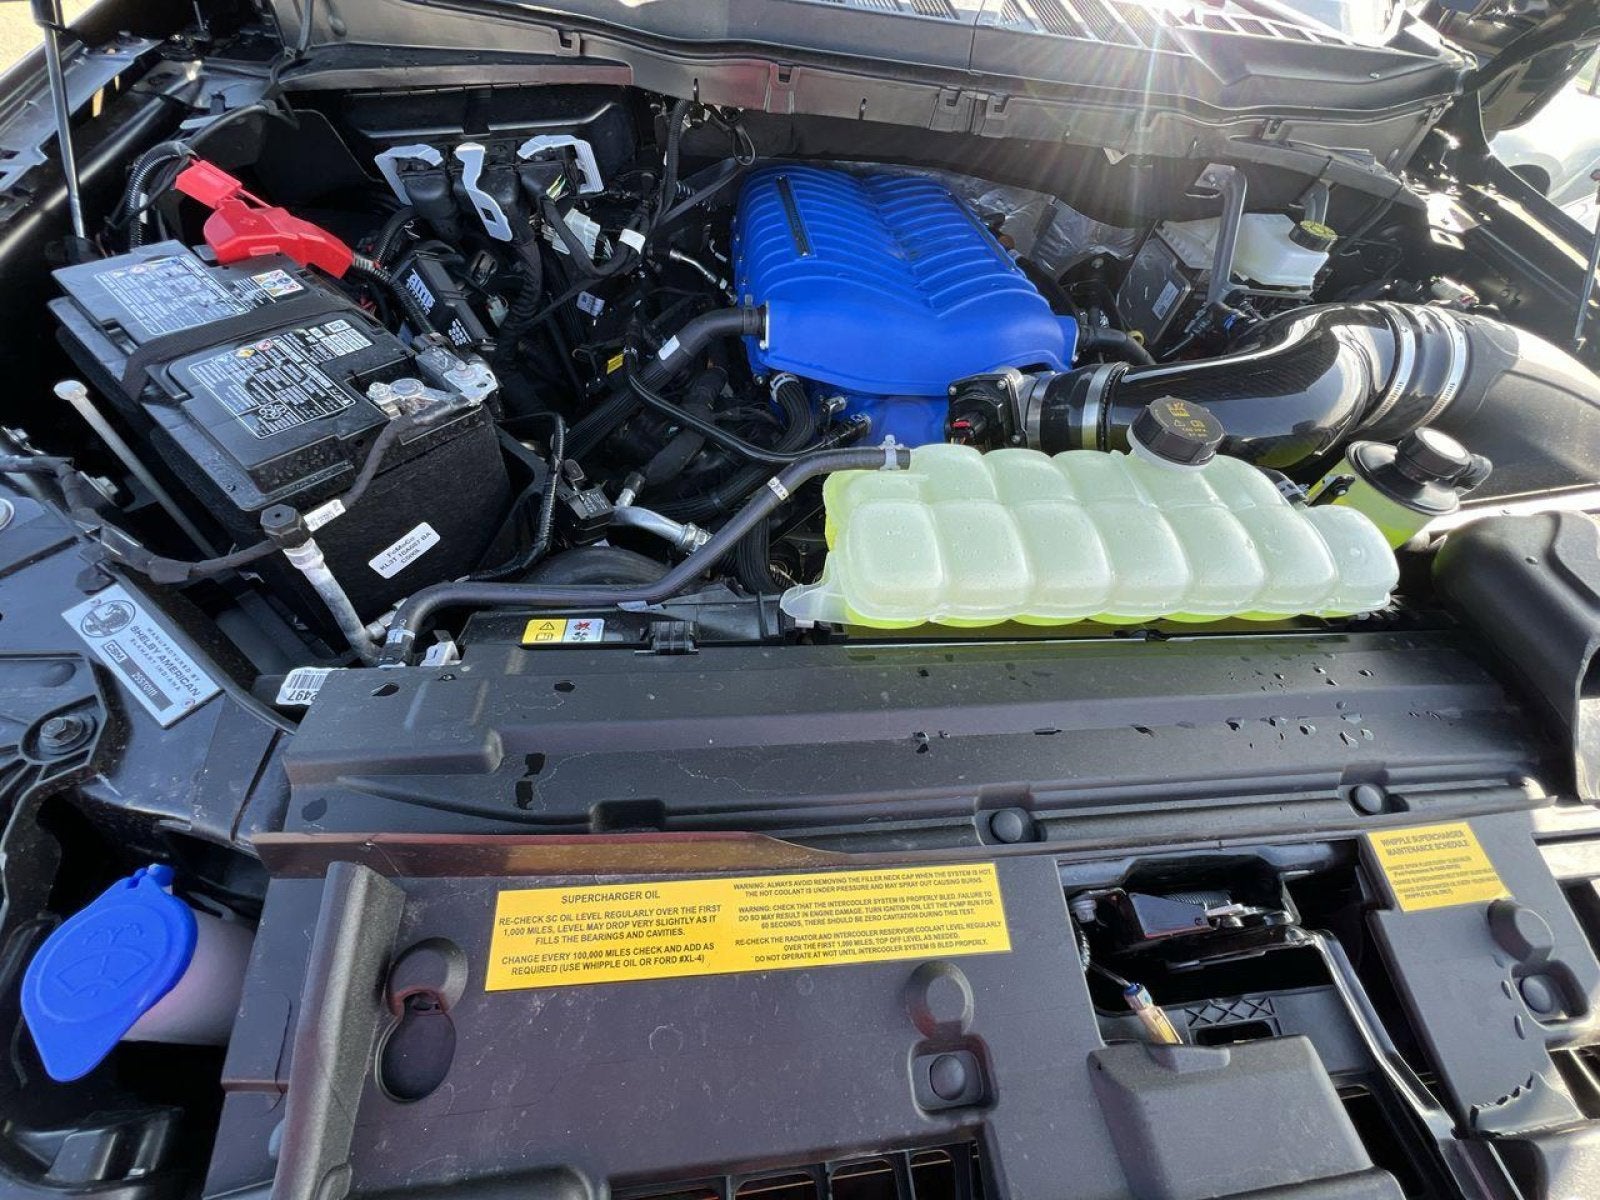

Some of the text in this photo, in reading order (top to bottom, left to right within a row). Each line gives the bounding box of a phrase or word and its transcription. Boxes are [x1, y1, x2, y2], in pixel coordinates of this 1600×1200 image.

[106, 643, 125, 661] CSM
[146, 627, 191, 673] MANUFACTURED
[130, 625, 200, 697] SHELBY AMERICAN
[561, 891, 660, 904] SUPERCHARGER OIL
[827, 899, 871, 907] INTERCOOLER
[498, 915, 544, 925] RE-CHECK
[545, 914, 558, 923] SC
[559, 913, 572, 922] OIL
[575, 912, 602, 921] LEVEL
[604, 909, 654, 919] REGULARLY
[655, 908, 678, 916] OVER
[698, 905, 720, 913] FIRST
[504, 927, 525, 935] 1,000
[557, 924, 584, 932] LEVEL
[605, 921, 629, 929] DROP
[655, 917, 694, 926] SLIGHTLY
[734, 937, 769, 945] RE-CHECK
[784, 934, 817, 942] RADIATOR
[833, 930, 877, 939] INTERCOOLER
[878, 928, 914, 936] RESERVOIR
[965, 922, 1000, 930] REGULARLY
[535, 929, 685, 945] FILLS THE BEARINGS AND CAVITIES.
[501, 943, 714, 964] CHANGE EVERY 100,000 MILES CHECK AND ADD AS
[857, 946, 902, 954] INTERCOOLER
[511, 955, 704, 975] REQUIRED (USE WHIPPLE OIL OR FORD #XL-4)
